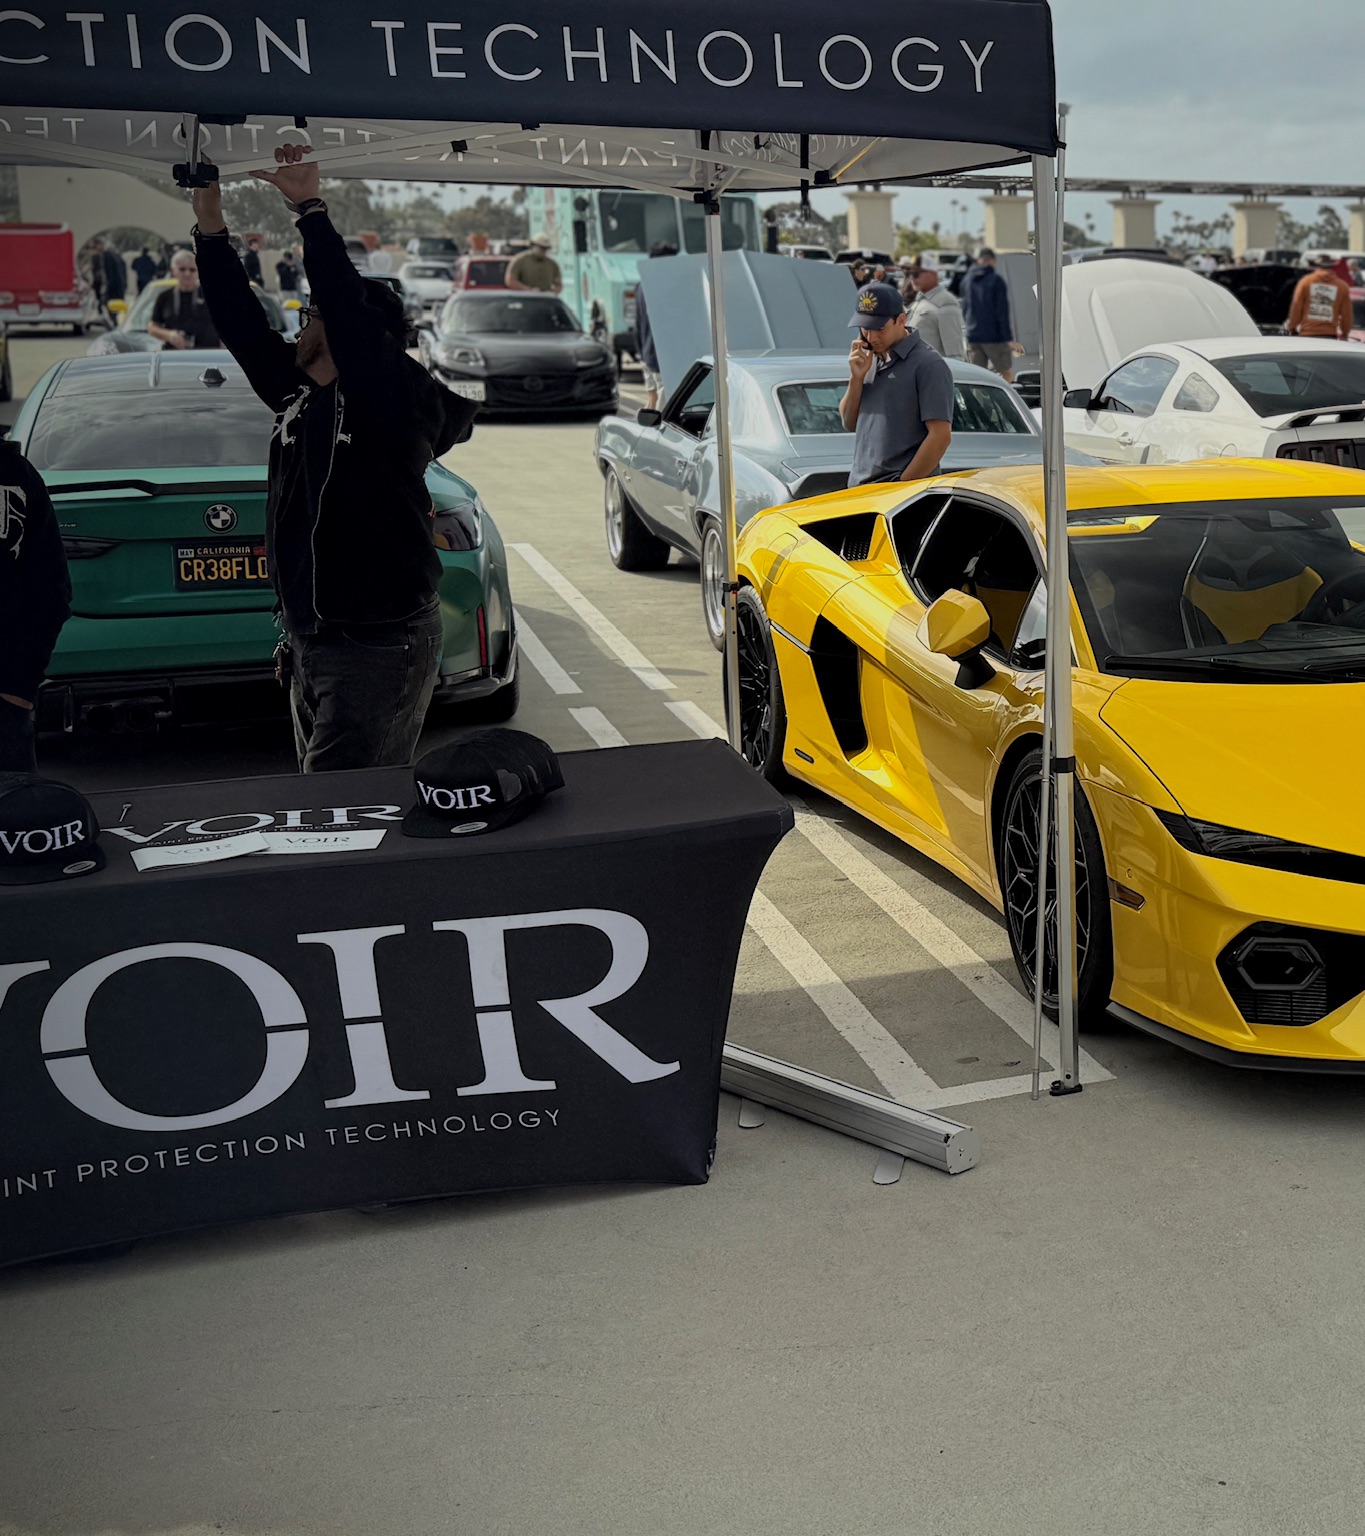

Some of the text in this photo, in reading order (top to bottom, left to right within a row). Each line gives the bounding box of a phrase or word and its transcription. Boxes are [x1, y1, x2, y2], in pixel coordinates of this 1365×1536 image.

[370, 20, 994, 93] TECHNOLOGY
[196, 546, 251, 555] CALIFORNIA
[417, 780, 496, 809] VOIR
[0, 819, 85, 854] VOIR
[100, 805, 404, 843] VOIR
[286, 836, 351, 845] VOIR
[3, 1108, 560, 1197] INT PROTECTION TECHNOLOGY
